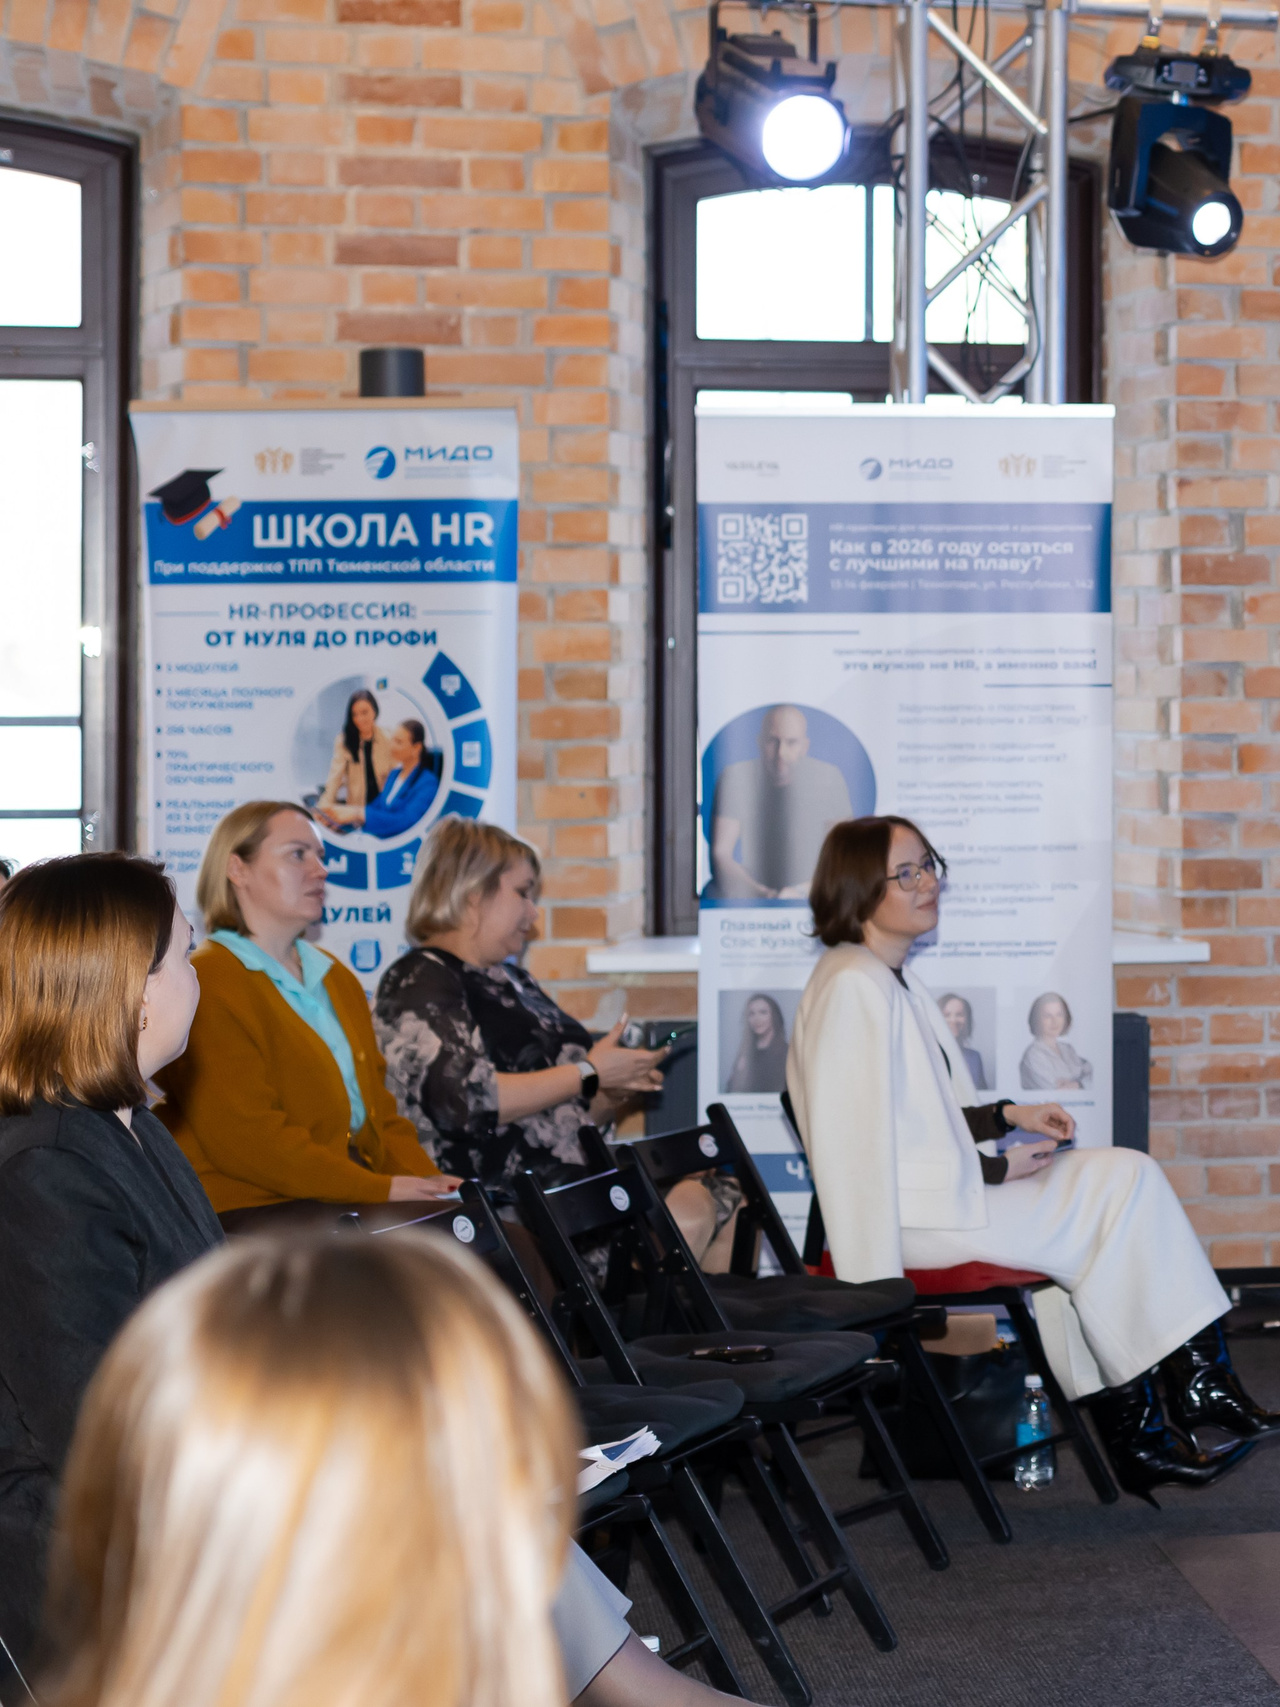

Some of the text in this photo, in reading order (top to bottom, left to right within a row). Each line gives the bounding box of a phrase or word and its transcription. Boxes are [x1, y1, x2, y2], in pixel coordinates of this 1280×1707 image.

[404, 446, 494, 462] МИДО
[889, 458, 953, 469] МИДО
[253, 513, 494, 548] ШКОЛА HR
[829, 539, 1074, 558] Как в 2026 году остаться
[154, 559, 495, 577] При поддержке ТПП Тюменской области
[829, 556, 1043, 575] с лучшими на плаву?
[229, 604, 417, 621] HR-ПРОФЕССИЯ:
[205, 630, 438, 648] ОТ НУЛЯ ДО ПРОФИ
